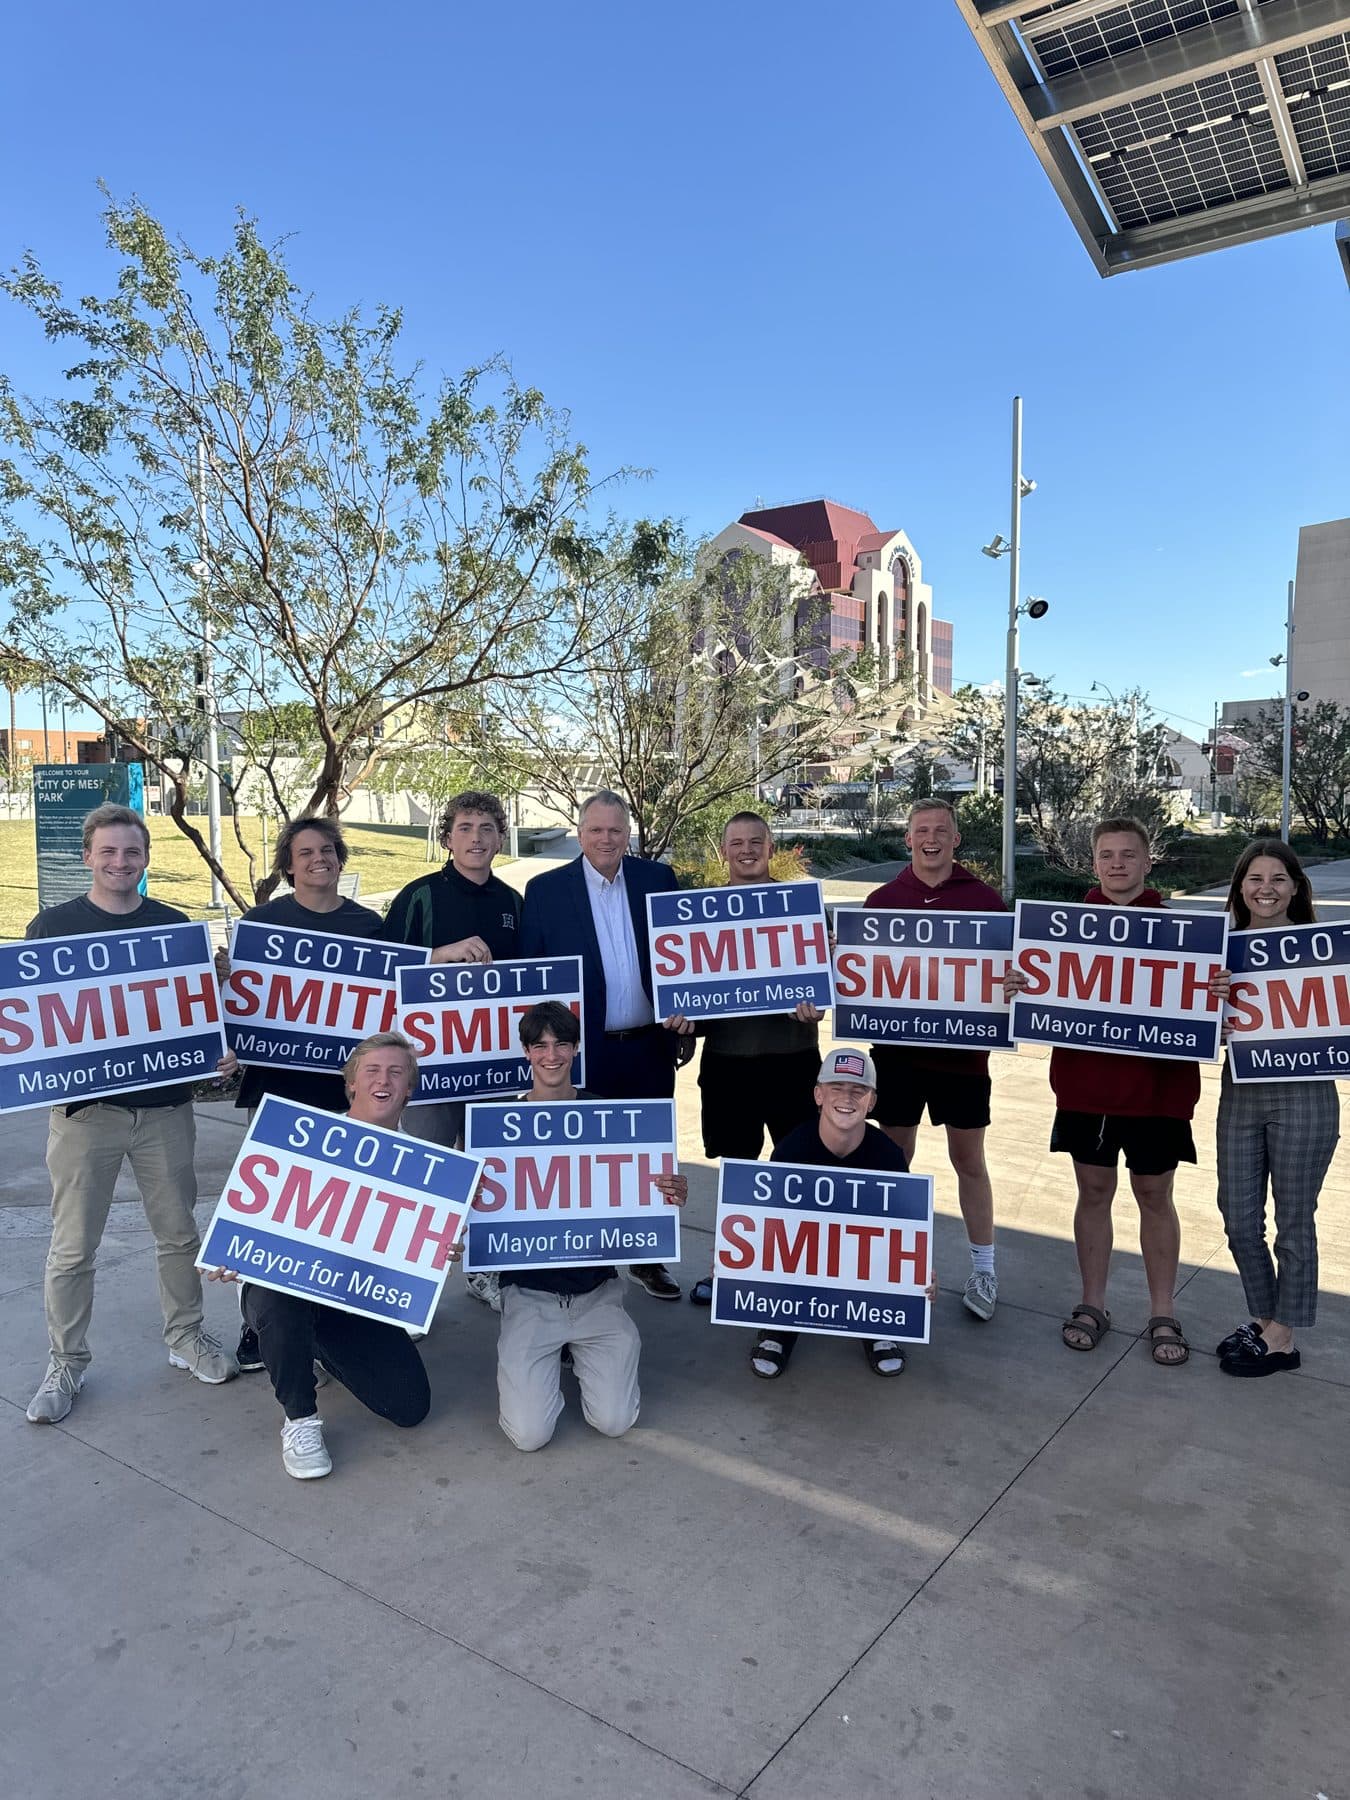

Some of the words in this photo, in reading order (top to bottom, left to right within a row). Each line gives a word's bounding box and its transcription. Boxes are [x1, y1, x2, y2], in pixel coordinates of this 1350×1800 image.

[38, 780, 59, 790] CITY
[61, 780, 76, 790] OF
[38, 792, 64, 802] PARK
[677, 890, 793, 920] SCOTT
[863, 917, 988, 944] SCOTT
[1049, 911, 1192, 946] SCOTT
[18, 935, 172, 980] SCOTT
[265, 934, 399, 975] SCOTT
[655, 923, 827, 977] SMITH
[1250, 931, 1350, 966] SCO
[429, 966, 552, 997] SCOTT
[836, 952, 1012, 1004] SMITH
[1018, 948, 1222, 1012] SMITH
[0, 972, 218, 1054] SMITH
[673, 991, 730, 1010] Mayor
[735, 987, 760, 1003] for
[766, 984, 815, 1001] Mesa
[1228, 975, 1350, 1032] SMI
[403, 1001, 580, 1057] SMI
[851, 1013, 908, 1034] Mayor
[913, 1017, 939, 1034] for
[946, 1018, 997, 1037] Mesa
[1031, 1013, 1096, 1037] Mayor
[1102, 1021, 1132, 1040] for
[1138, 1025, 1196, 1047] Mesa
[235, 1033, 300, 1057] Mayor
[305, 1042, 333, 1060] for
[1251, 1049, 1320, 1070] Mayor
[1326, 1046, 1350, 1065] fo
[19, 1067, 96, 1094] Mayor
[103, 1059, 135, 1079] for
[143, 1050, 205, 1072] Mesa
[421, 1073, 481, 1091] Mayor
[486, 1068, 512, 1084] for
[503, 1110, 642, 1141] SCOTT
[288, 1117, 445, 1185] SCOTT
[471, 1154, 673, 1212] SMITH
[753, 1172, 896, 1211] SCOTT
[227, 1153, 460, 1269] SMITH
[489, 1233, 557, 1257] Mayor
[563, 1230, 593, 1250] for
[601, 1228, 657, 1248] Mesa
[718, 1215, 928, 1286] SMITH
[226, 1235, 305, 1276] Mayor
[309, 1260, 344, 1287] for
[347, 1271, 412, 1309] Mesa
[735, 1290, 803, 1318] Mayor
[809, 1297, 839, 1318] for
[847, 1300, 905, 1325] Mesa
